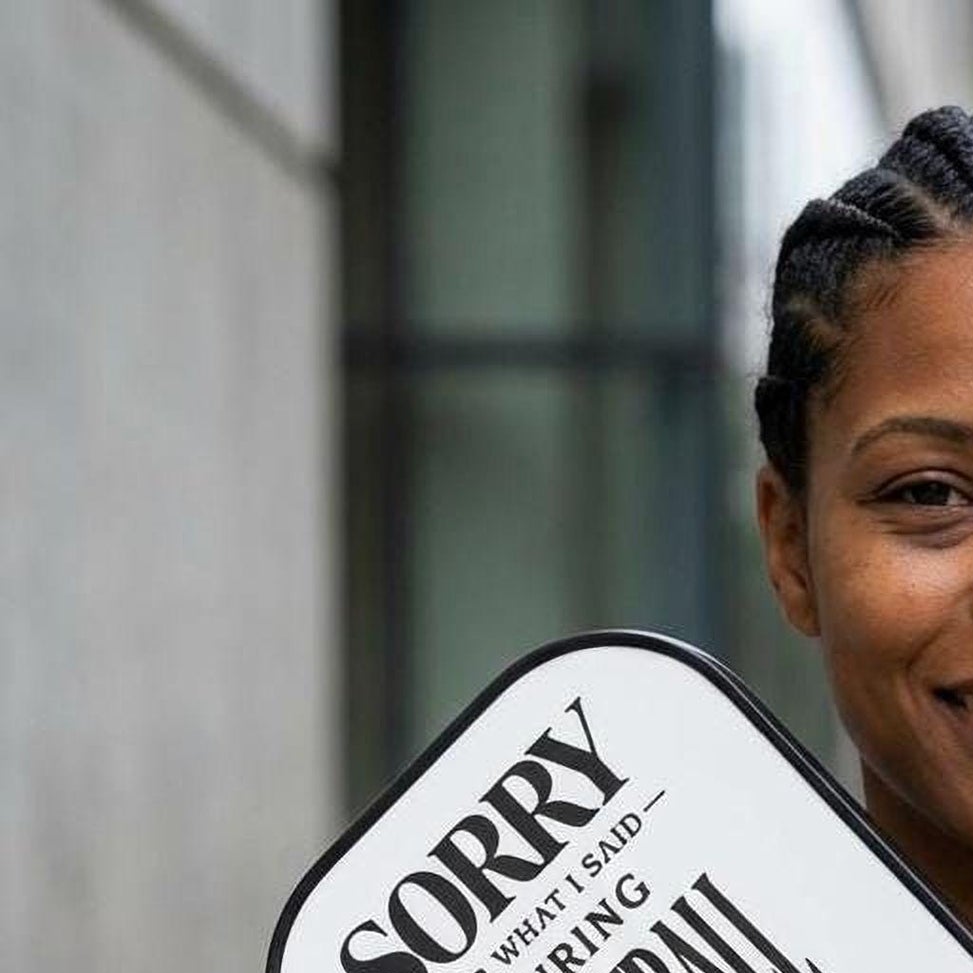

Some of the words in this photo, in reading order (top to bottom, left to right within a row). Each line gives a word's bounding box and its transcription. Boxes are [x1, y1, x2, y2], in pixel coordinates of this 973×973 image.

[491, 888, 567, 967] WHAT
[565, 874, 584, 894] I
[581, 813, 642, 878] SAID
